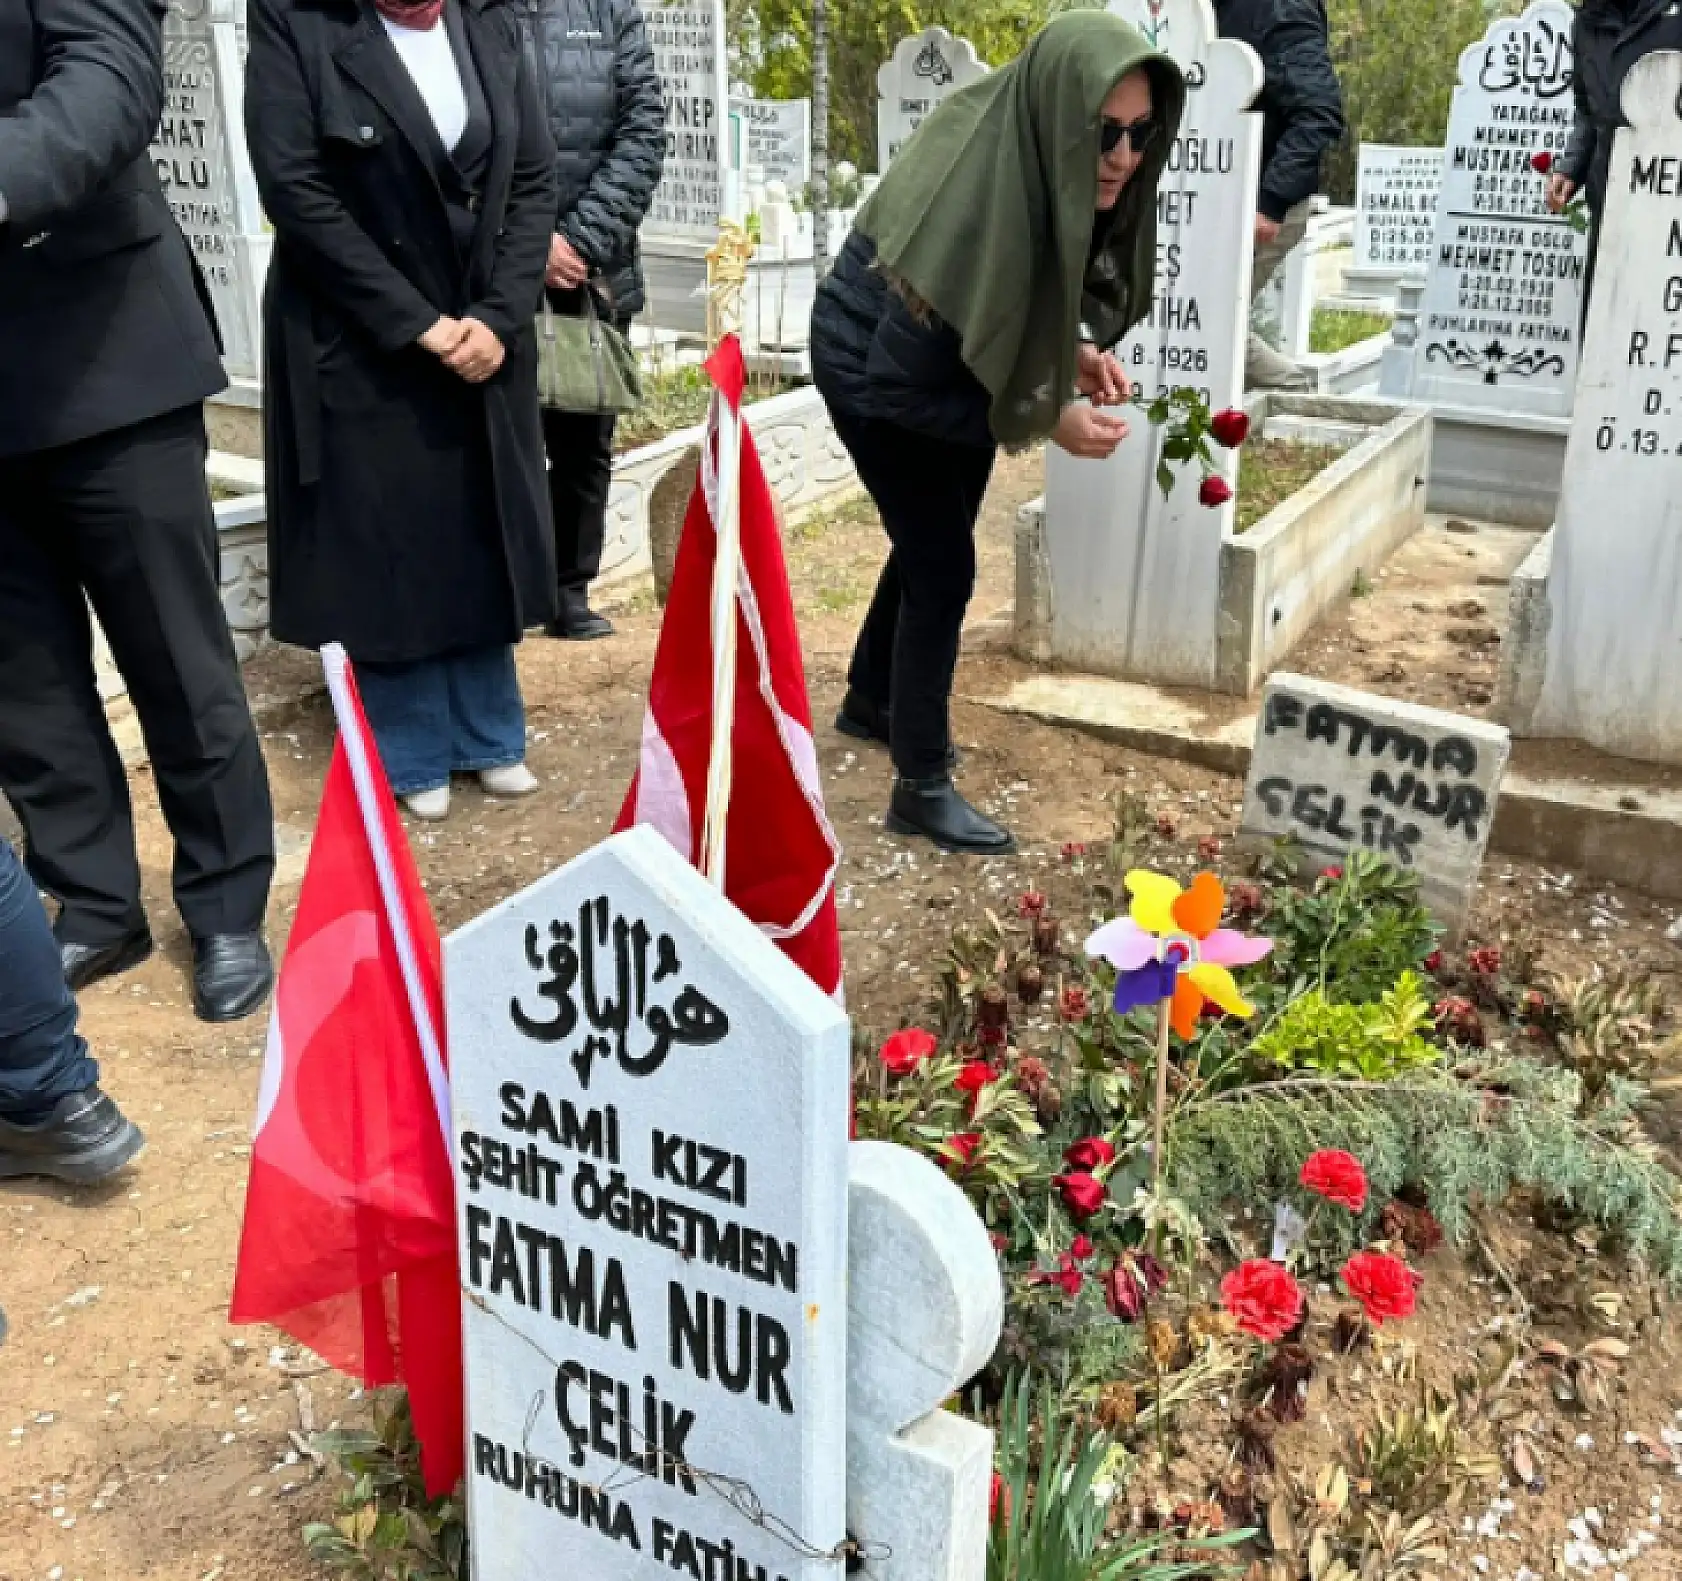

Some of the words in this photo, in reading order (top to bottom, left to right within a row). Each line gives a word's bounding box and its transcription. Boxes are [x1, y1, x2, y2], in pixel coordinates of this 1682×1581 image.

[151, 119, 206, 149] HAT
[1630, 156, 1682, 196] ME
[1438, 243, 1515, 272] MEHMET
[1521, 249, 1585, 280] TOSUN
[1457, 225, 1523, 245] MUSTAFA
[1137, 288, 1201, 332] TİHA
[1265, 693, 1478, 777] FATMA
[1370, 769, 1488, 841] NUR
[651, 1129, 748, 1208] KIZI
[460, 1131, 563, 1206] ŞEHİT
[571, 1160, 797, 1294] ÖĞRETMEN
[466, 1203, 638, 1352] FATMA
[667, 1280, 795, 1415] NUR
[554, 1359, 697, 1497] ÇELİK
[474, 1432, 642, 1552] RUHUNA
[651, 1515, 790, 1581] FATİH
